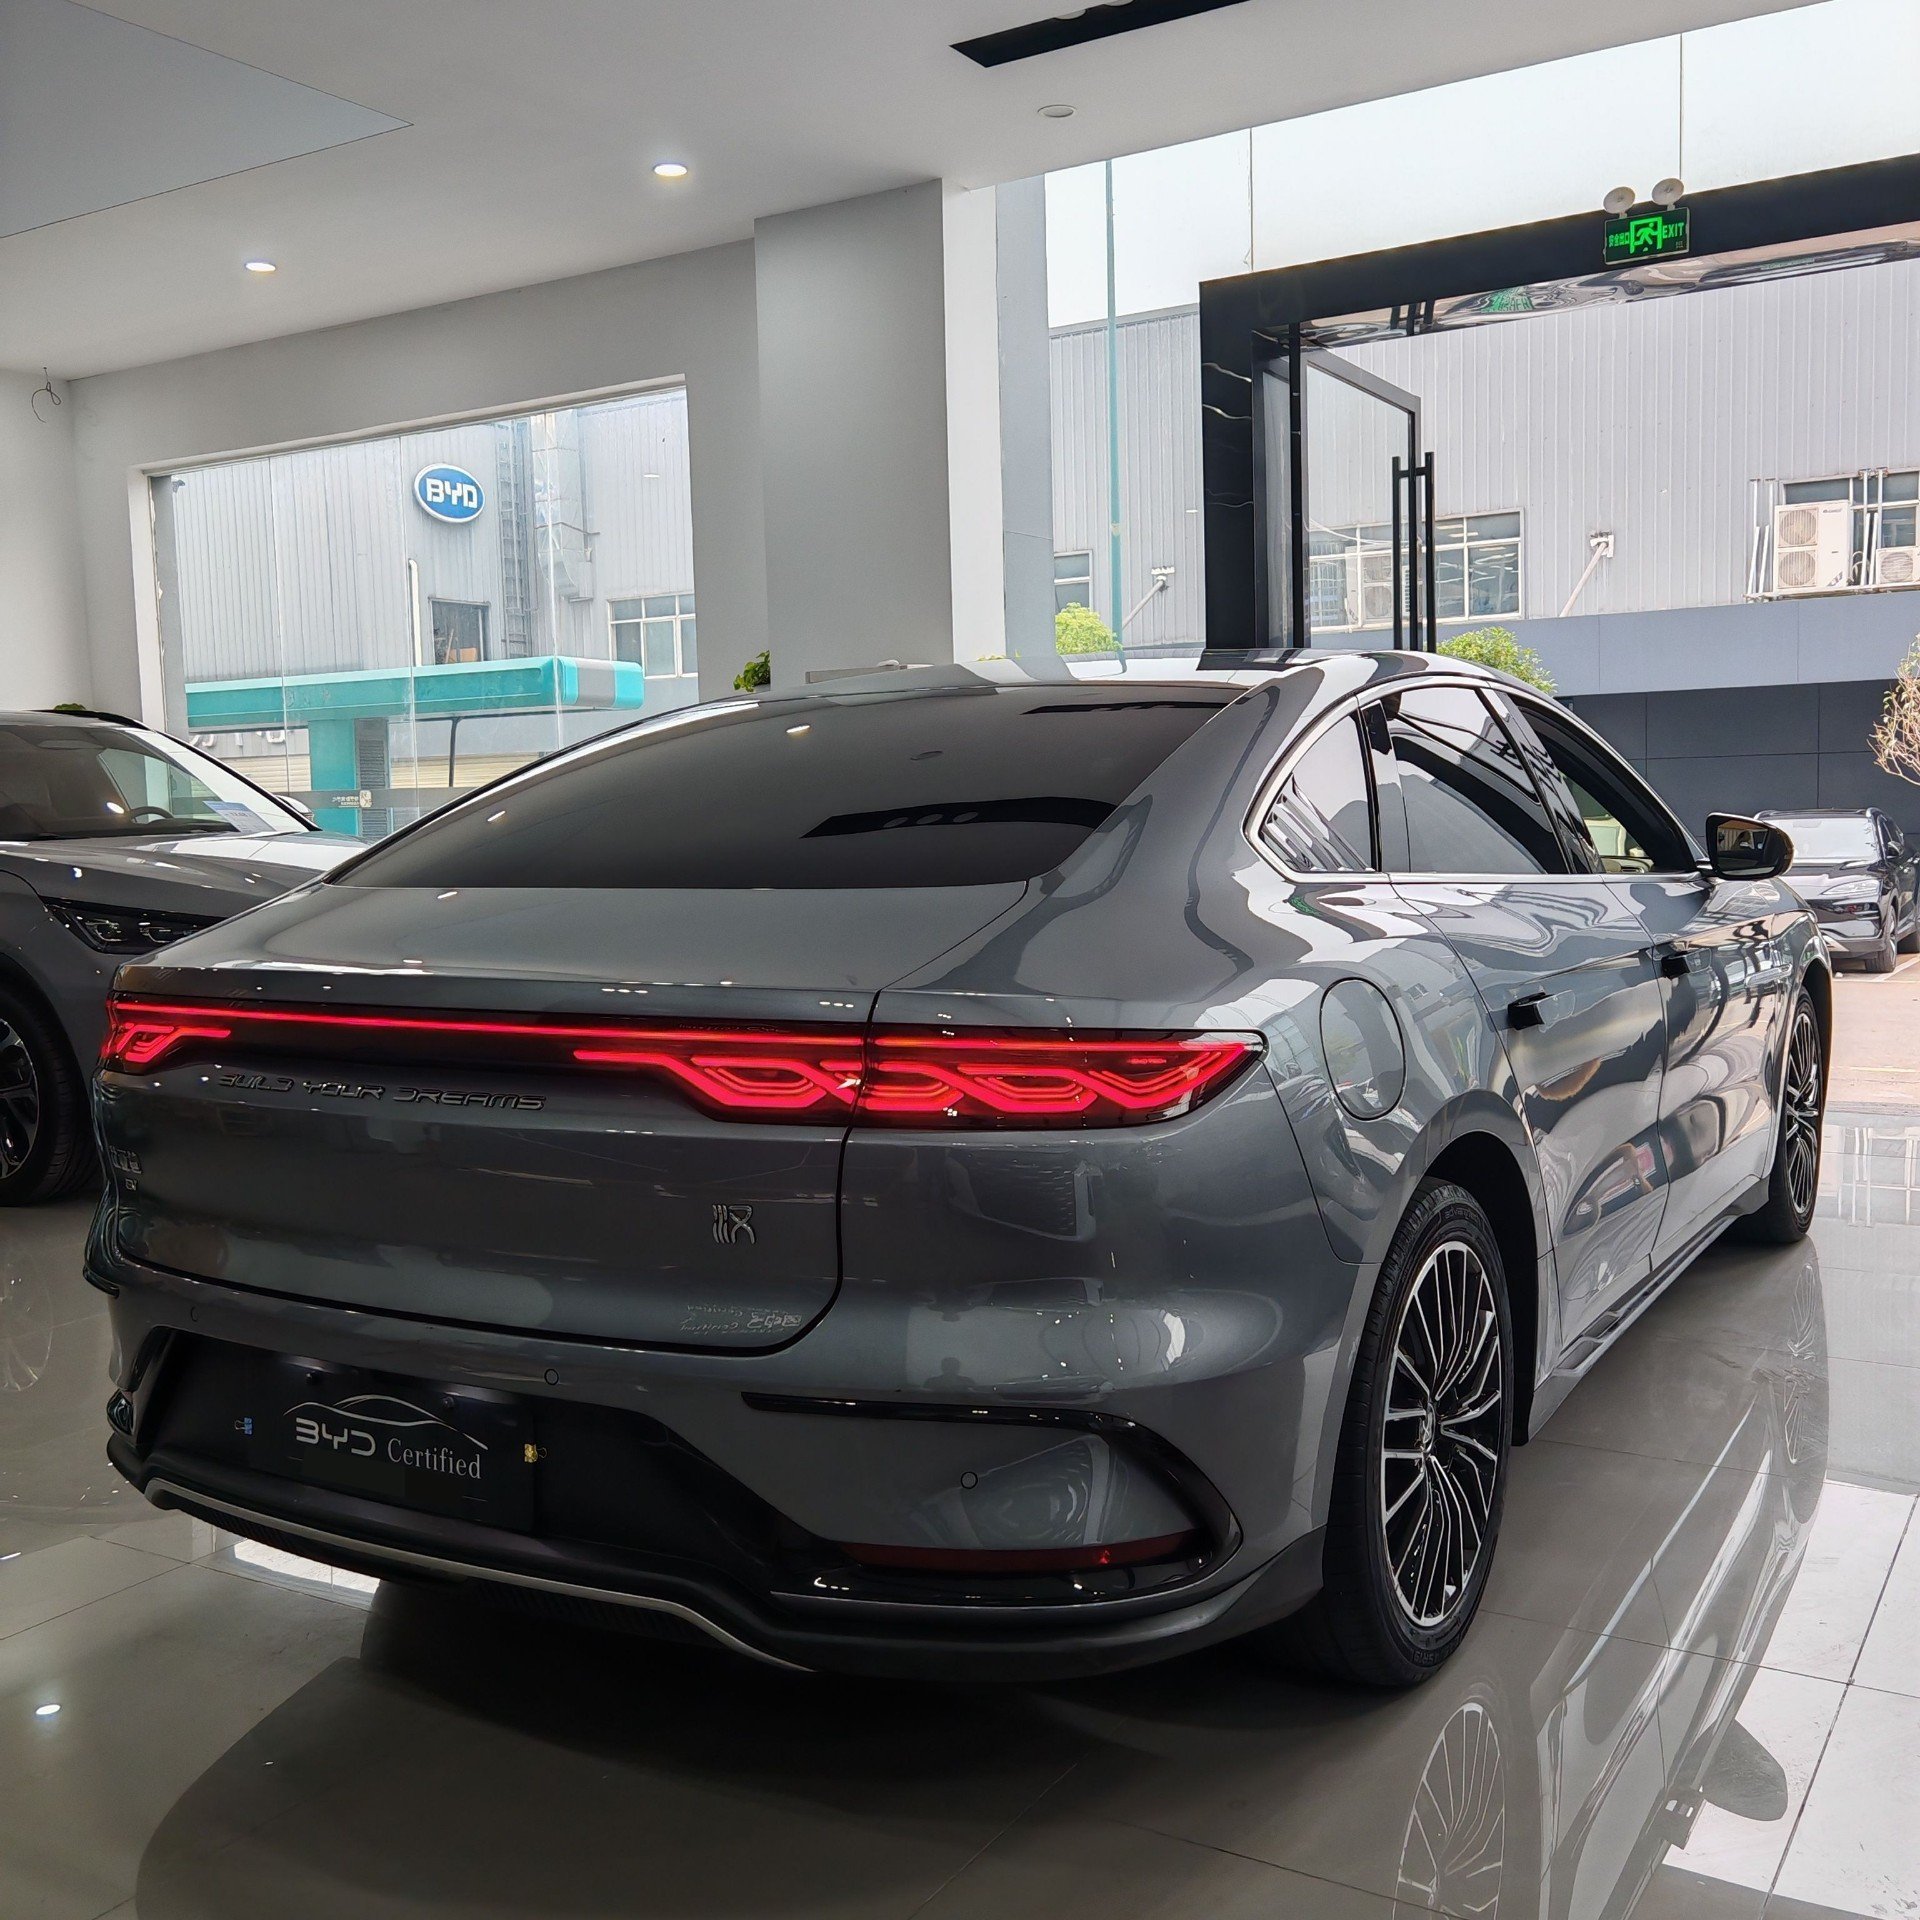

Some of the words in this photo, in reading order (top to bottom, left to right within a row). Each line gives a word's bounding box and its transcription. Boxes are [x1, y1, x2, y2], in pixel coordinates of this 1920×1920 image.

[1662, 222, 1684, 239] EXIT
[425, 477, 478, 509] BYD
[218, 1073, 294, 1092] BUILD
[302, 1081, 386, 1100] YOUR
[392, 1086, 547, 1111] DREAMS
[295, 1416, 376, 1457] BYD
[387, 1437, 482, 1480] Certified
